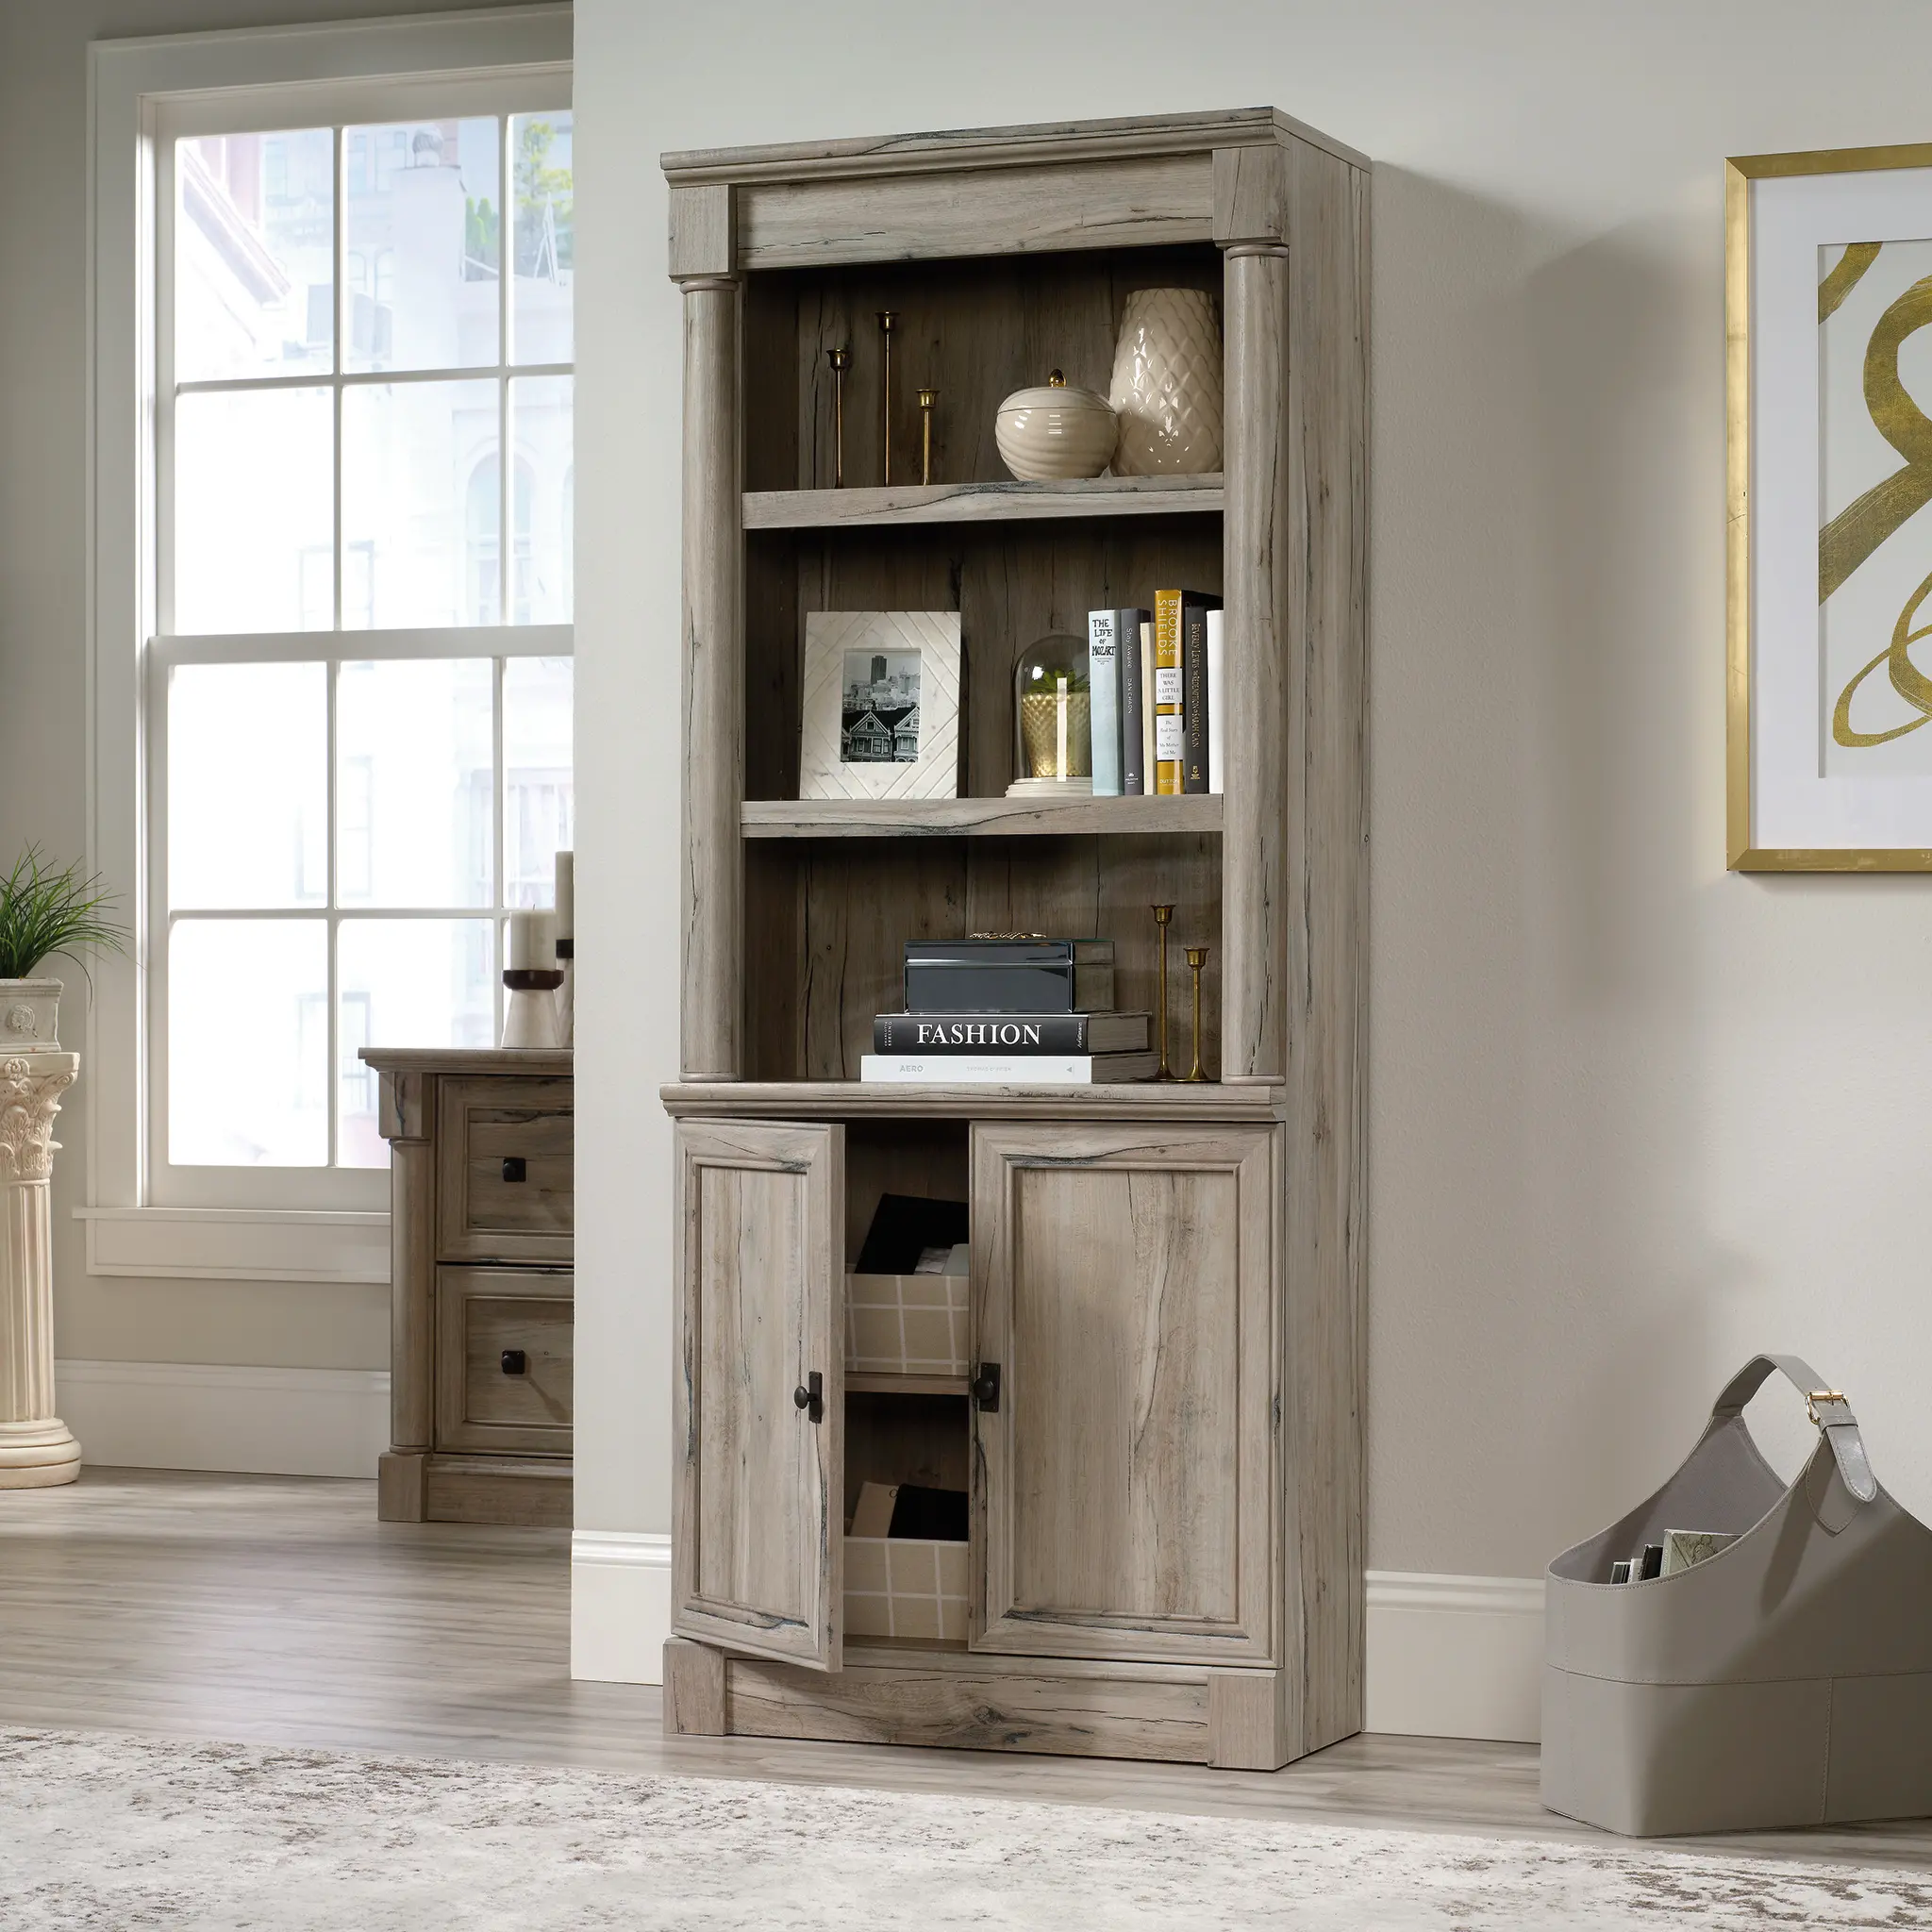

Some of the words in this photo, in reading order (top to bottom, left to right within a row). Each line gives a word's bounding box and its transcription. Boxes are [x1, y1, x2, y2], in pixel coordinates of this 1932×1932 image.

[1092, 619, 1109, 627] THE
[1158, 600, 1167, 656] SHIELDS
[1168, 599, 1177, 656] BROOKE
[1091, 646, 1116, 656] MOZART
[917, 1024, 1041, 1044] FASHION
